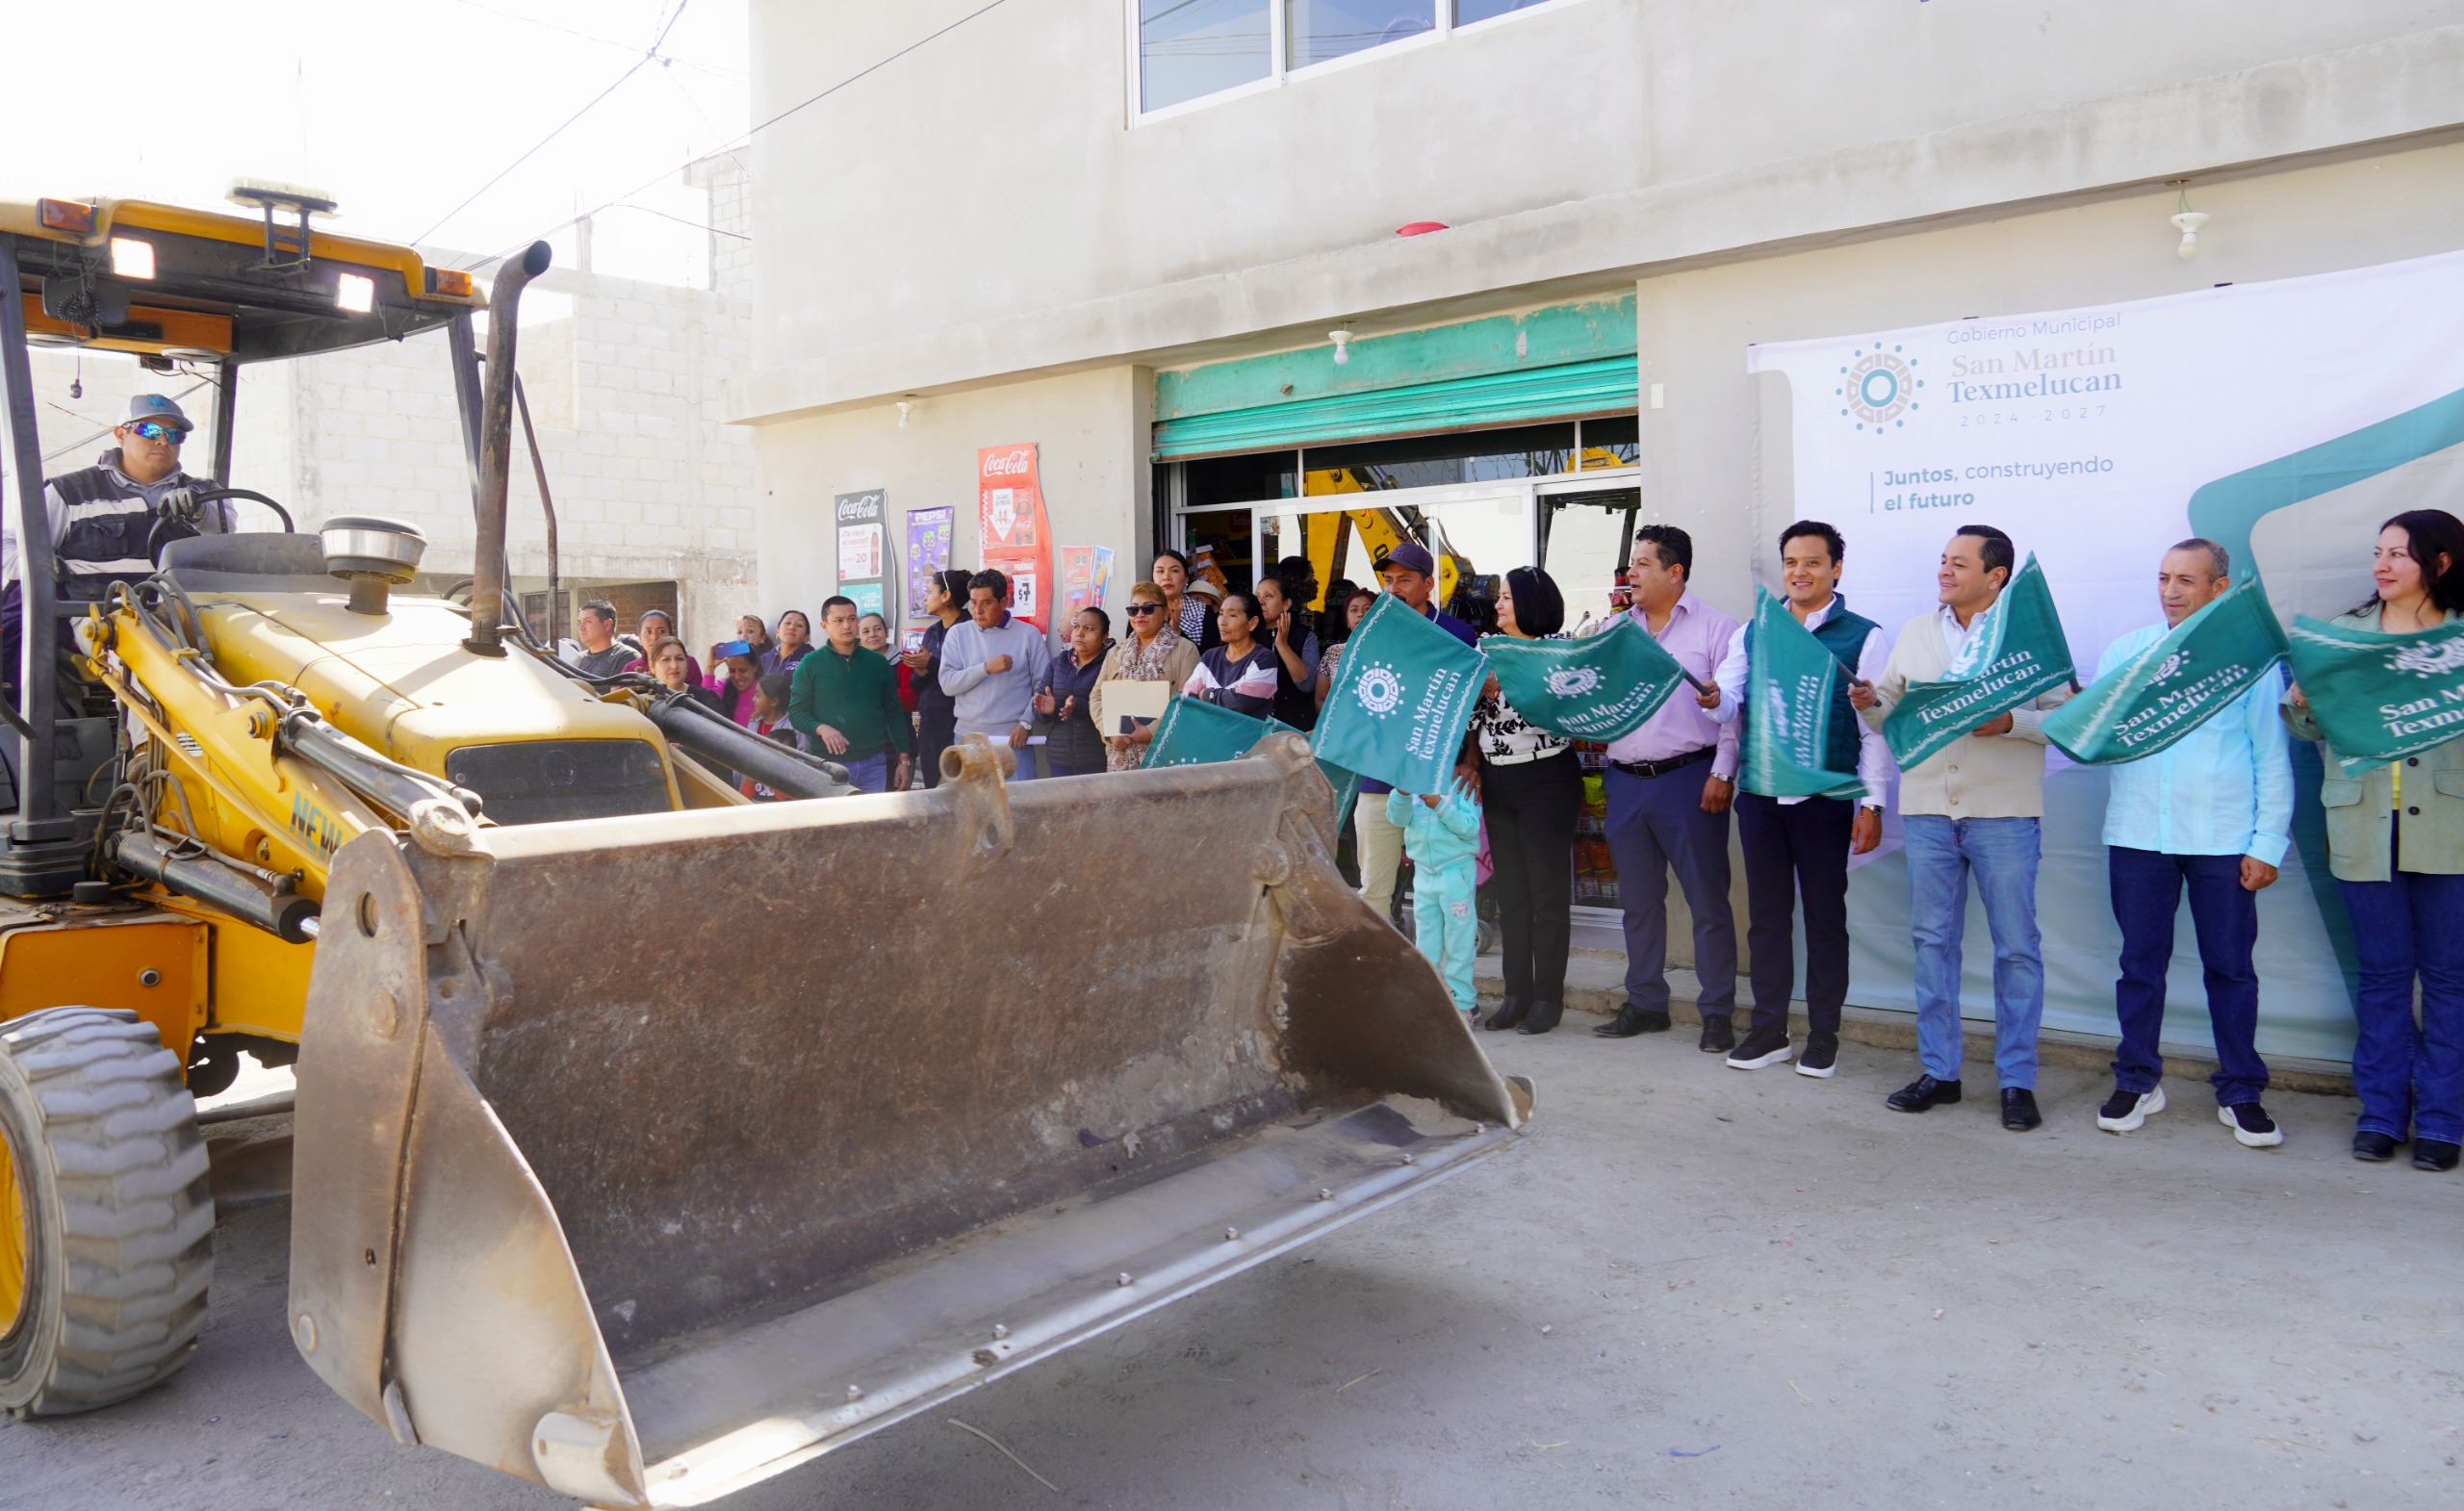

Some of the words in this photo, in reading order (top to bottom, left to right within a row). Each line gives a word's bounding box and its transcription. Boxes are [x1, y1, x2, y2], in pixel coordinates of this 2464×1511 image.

[1947, 326, 2027, 345] Gobierno
[2032, 312, 2121, 334] Municipal
[1951, 354, 2005, 378] San
[2013, 342, 2117, 372] Martín
[1946, 371, 2123, 403] Texmelucan
[1884, 468, 1959, 486] Juntos,
[1964, 455, 2114, 479] construyendo
[1884, 494, 1902, 511] el
[1909, 492, 1975, 509] futuro
[1413, 668, 1448, 725] Martín
[1916, 662, 2042, 725] Texmelucan
[2116, 667, 2249, 748] Texmelucan
[2378, 698, 2440, 721] San
[1418, 672, 1462, 760] Texmelucan
[2112, 707, 2158, 736] San
[2381, 707, 2464, 738] Texm
[1405, 727, 1424, 756] San
